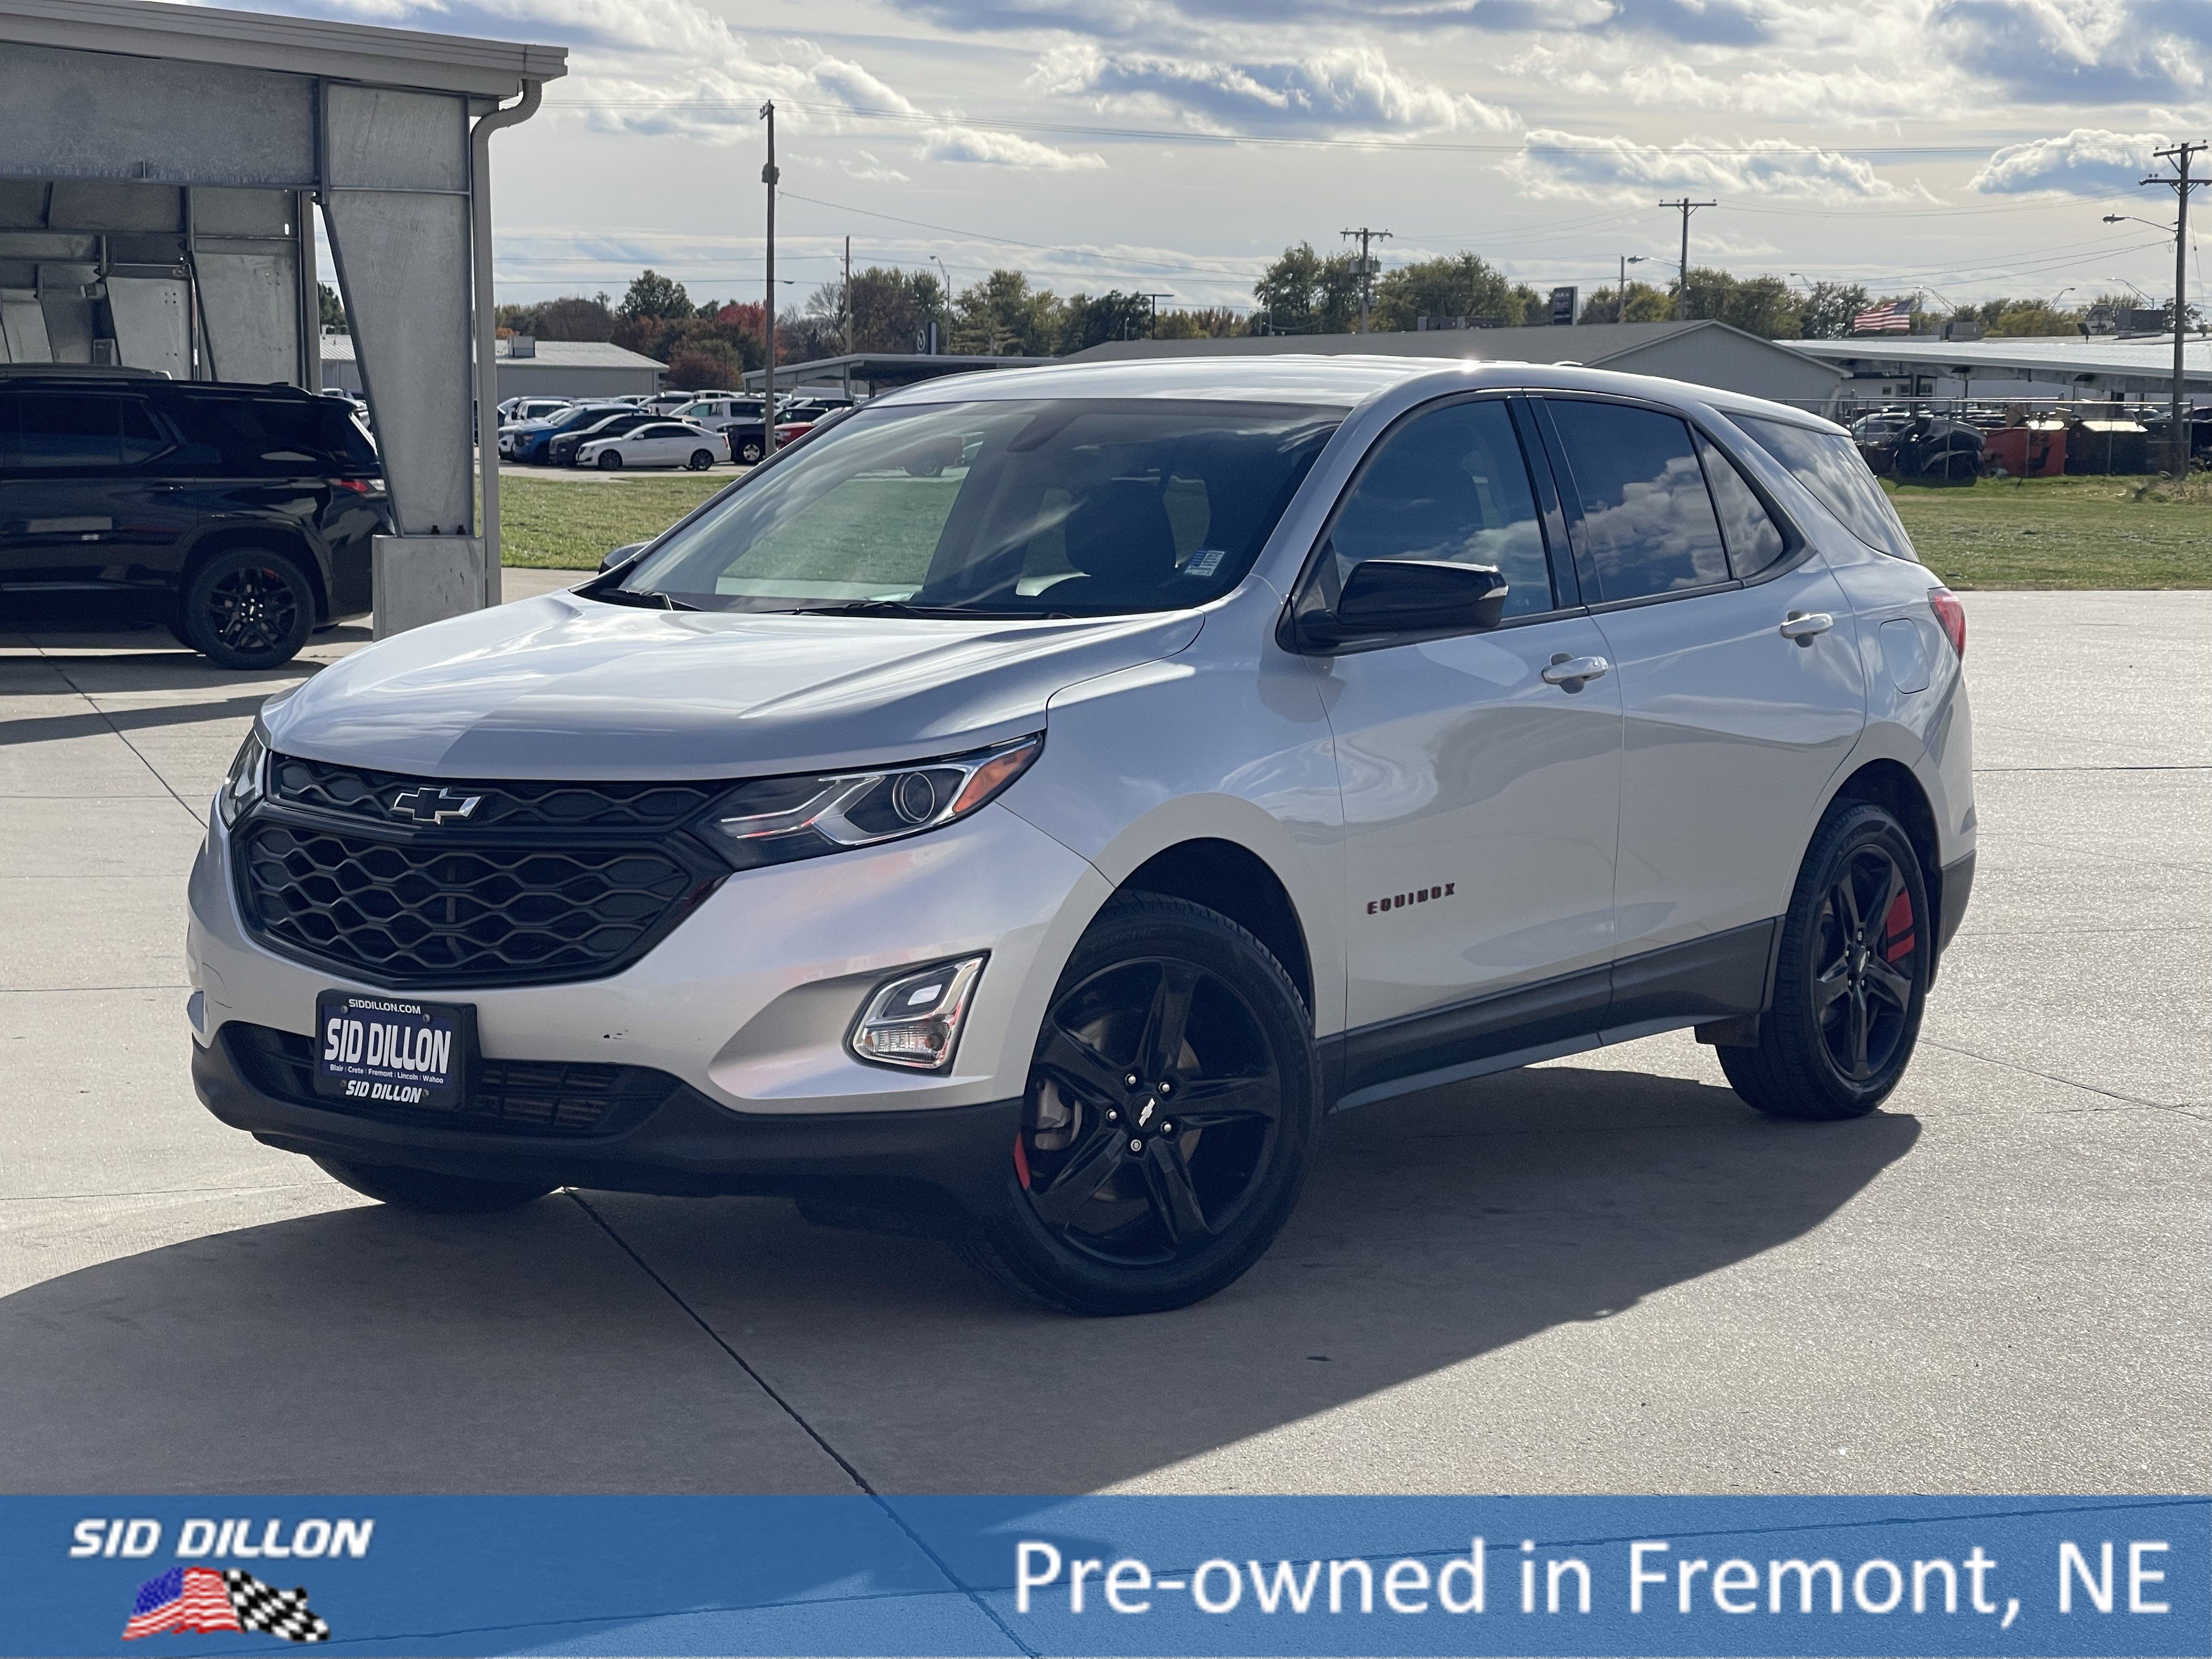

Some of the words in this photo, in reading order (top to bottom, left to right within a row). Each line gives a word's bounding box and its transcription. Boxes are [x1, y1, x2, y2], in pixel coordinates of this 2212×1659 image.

[1366, 882, 1455, 915] EQUINOX
[348, 998, 421, 1014] SIDDILLON.COM
[324, 1018, 364, 1063] SID
[366, 1023, 451, 1074] DILLON
[330, 1064, 344, 1073] Blair
[347, 1066, 364, 1075] Crete
[368, 1068, 393, 1078] Fremont
[397, 1071, 419, 1081] Lincoln
[423, 1075, 444, 1084] Wahoo
[346, 1080, 370, 1097] SID
[371, 1084, 422, 1103] DILLON
